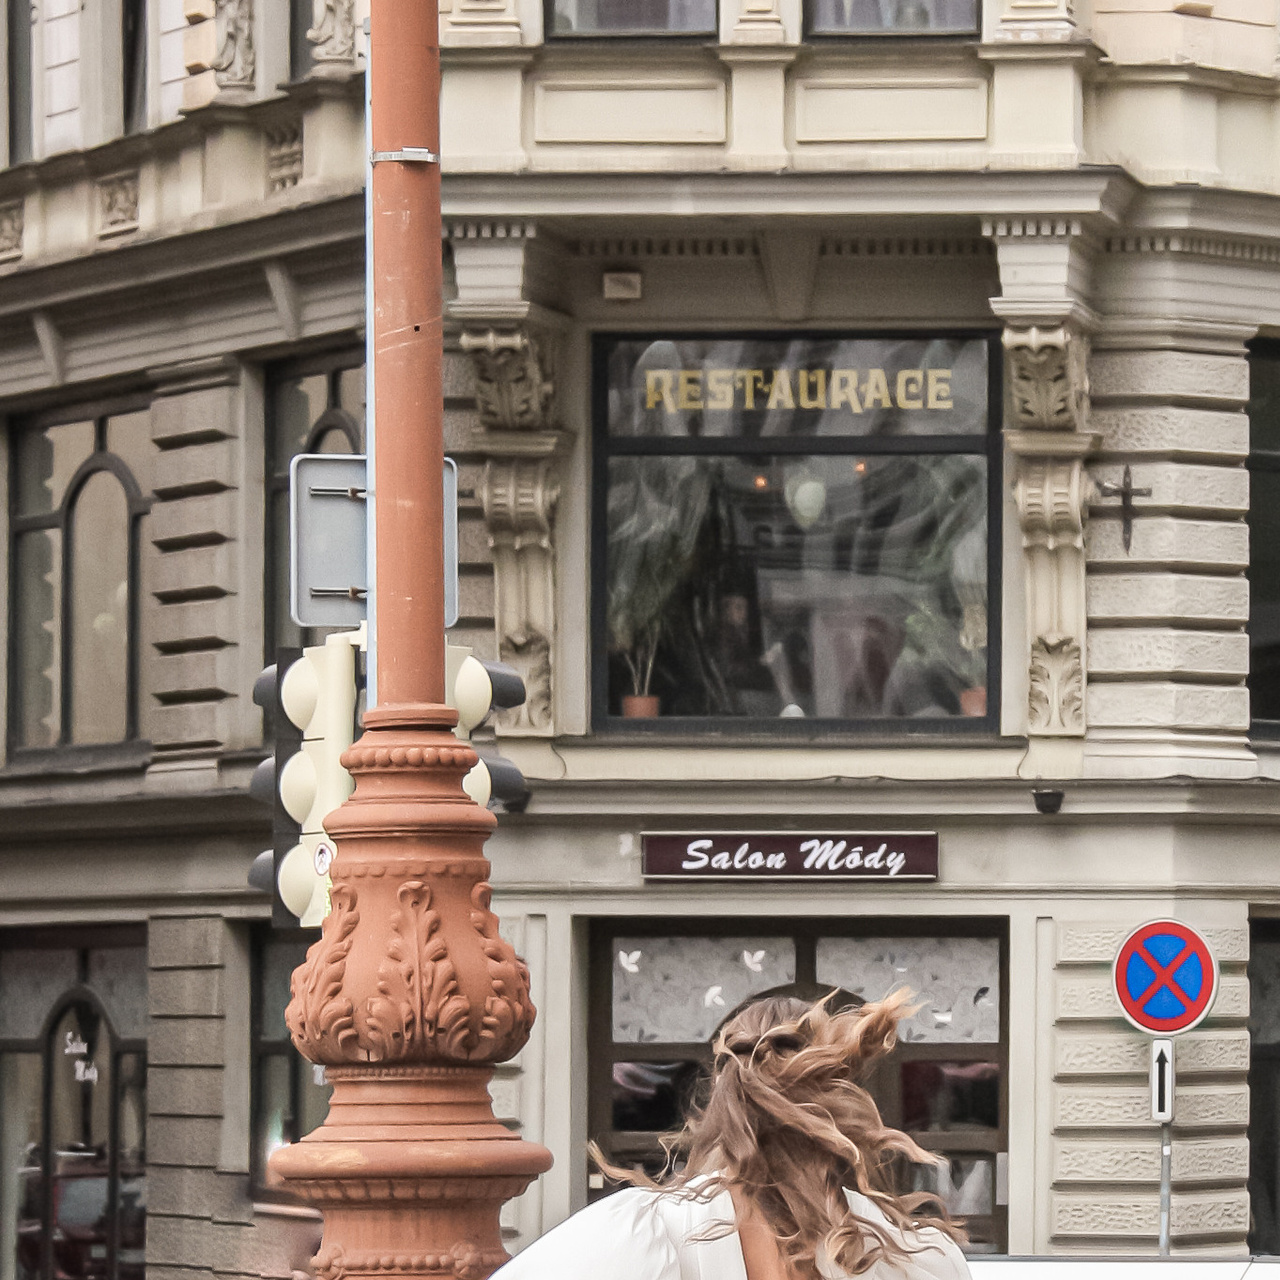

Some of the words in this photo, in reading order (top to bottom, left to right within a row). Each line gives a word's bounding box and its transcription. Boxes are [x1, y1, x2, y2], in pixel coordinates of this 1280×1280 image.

[645, 369, 954, 414] RESTAURACE
[681, 839, 788, 870] Salon
[800, 839, 906, 877] Módy
